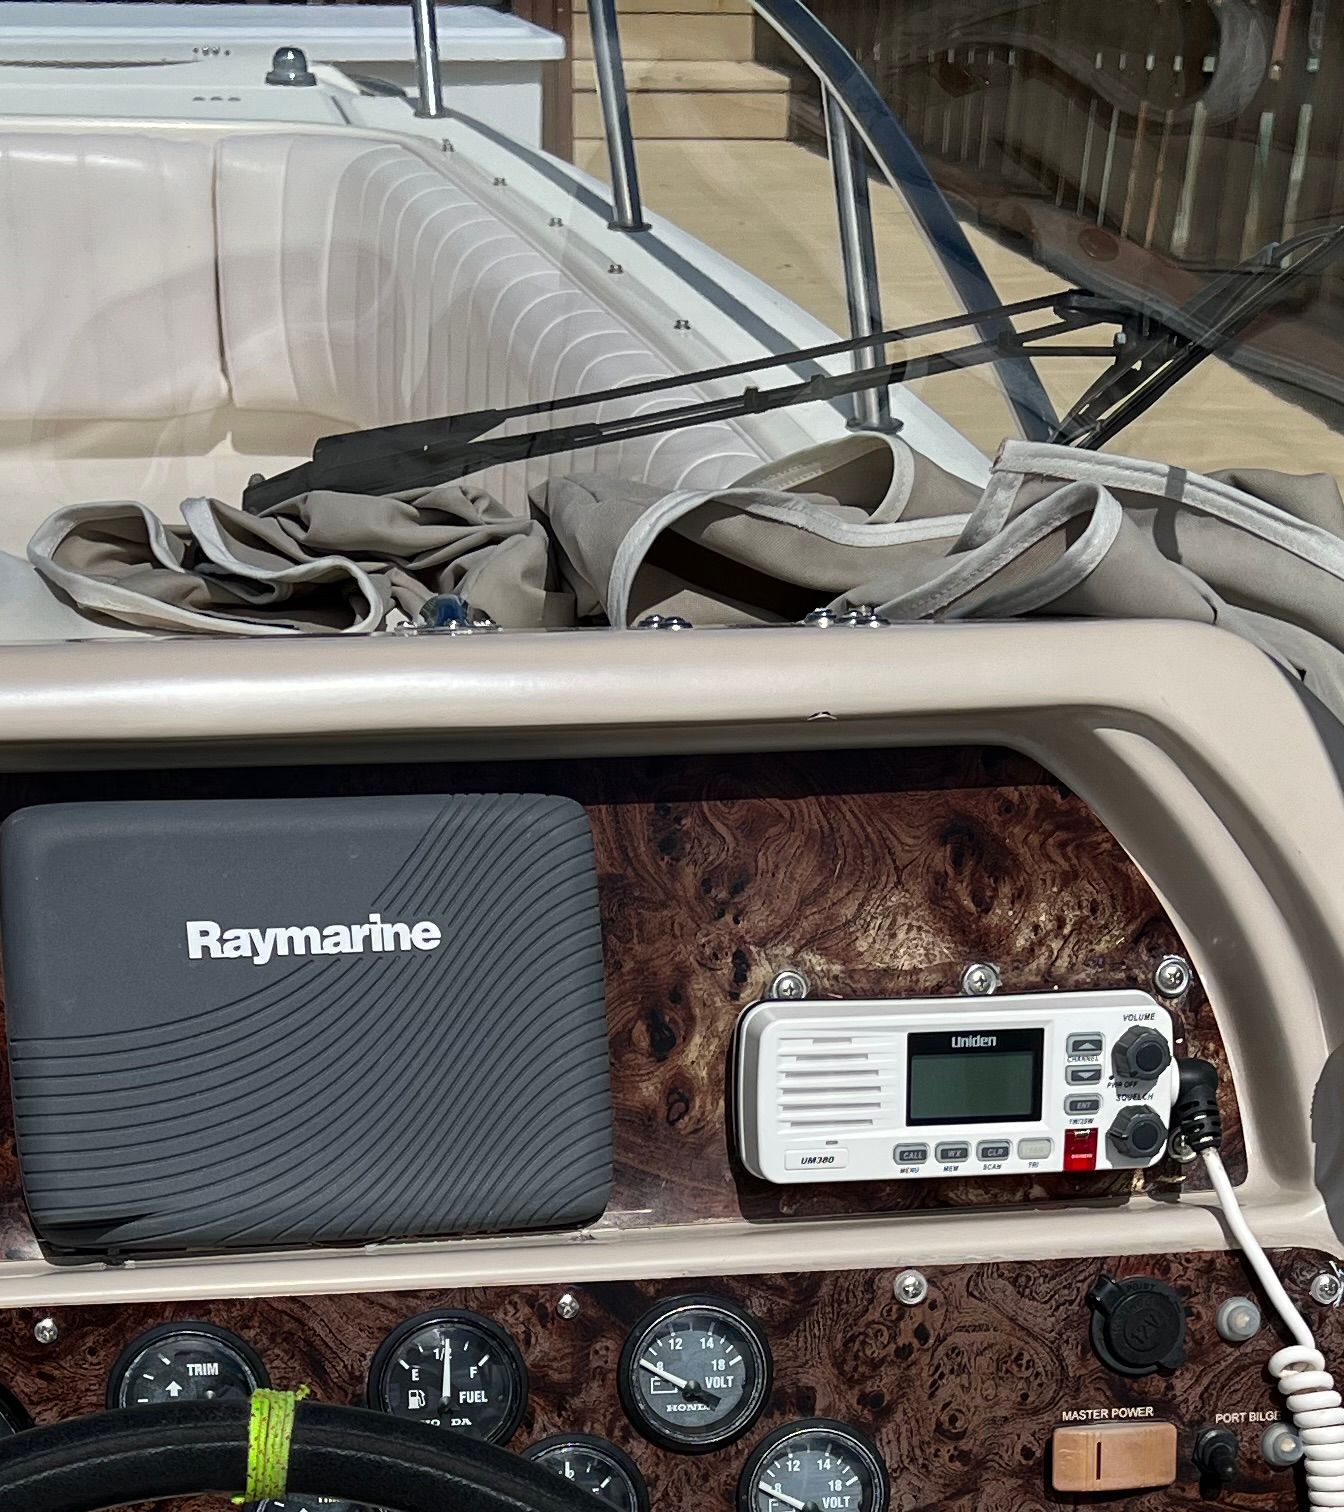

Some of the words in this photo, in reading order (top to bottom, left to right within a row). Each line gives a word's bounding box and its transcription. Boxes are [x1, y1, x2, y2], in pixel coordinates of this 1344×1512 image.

[187, 911, 442, 964] Raymarine
[1123, 1012, 1156, 1022] VOLUME
[951, 1034, 997, 1050] Uniden
[800, 1156, 835, 1165] UM380
[903, 1152, 923, 1160] CALL
[668, 1337, 683, 1350] 12
[700, 1337, 714, 1350] 14
[186, 1362, 219, 1377] TRIM
[711, 1358, 726, 1371] 18
[411, 1368, 420, 1381] E
[469, 1366, 478, 1379] F
[704, 1375, 735, 1389] VOLT
[459, 1390, 488, 1404] FUEL
[1062, 1409, 1109, 1421] MASTER
[1111, 1406, 1155, 1419] POWER
[1215, 1412, 1247, 1423] PORT
[786, 1459, 801, 1472] 12
[817, 1458, 831, 1471] 14
[828, 1479, 843, 1492] 18
[822, 1496, 851, 1509] VOLT
